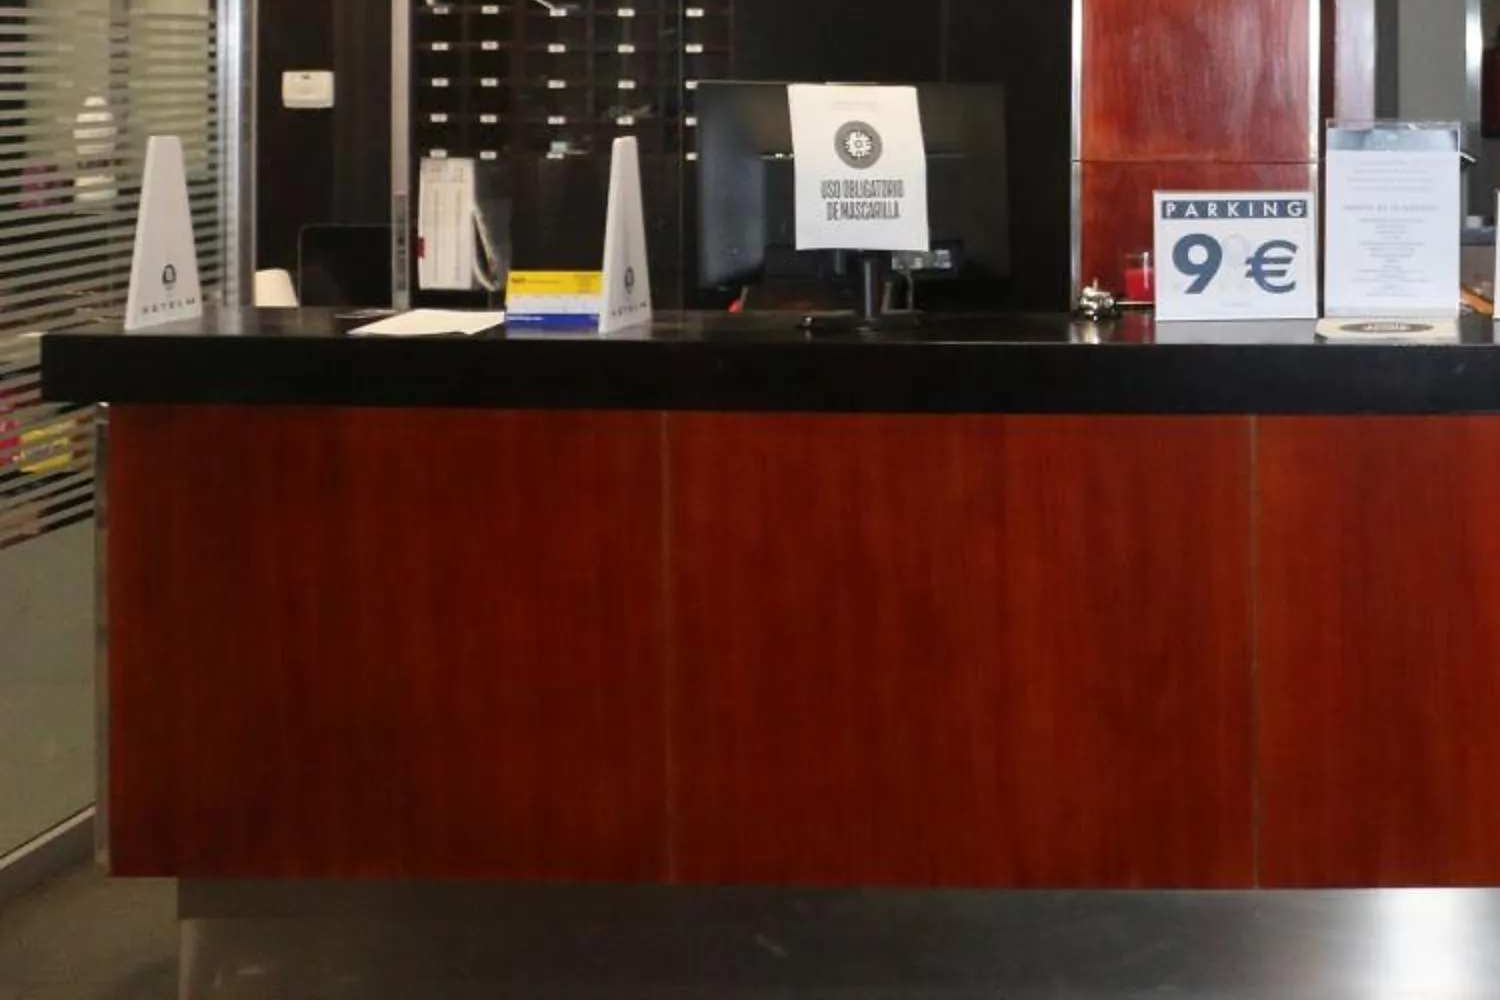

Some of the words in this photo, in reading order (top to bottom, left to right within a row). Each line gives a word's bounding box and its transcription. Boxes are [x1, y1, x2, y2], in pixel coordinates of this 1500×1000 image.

[821, 179, 841, 199] USO
[1165, 200, 1303, 217] PARKING
[1172, 233, 1223, 294] 9
[1244, 239, 1298, 294] €
